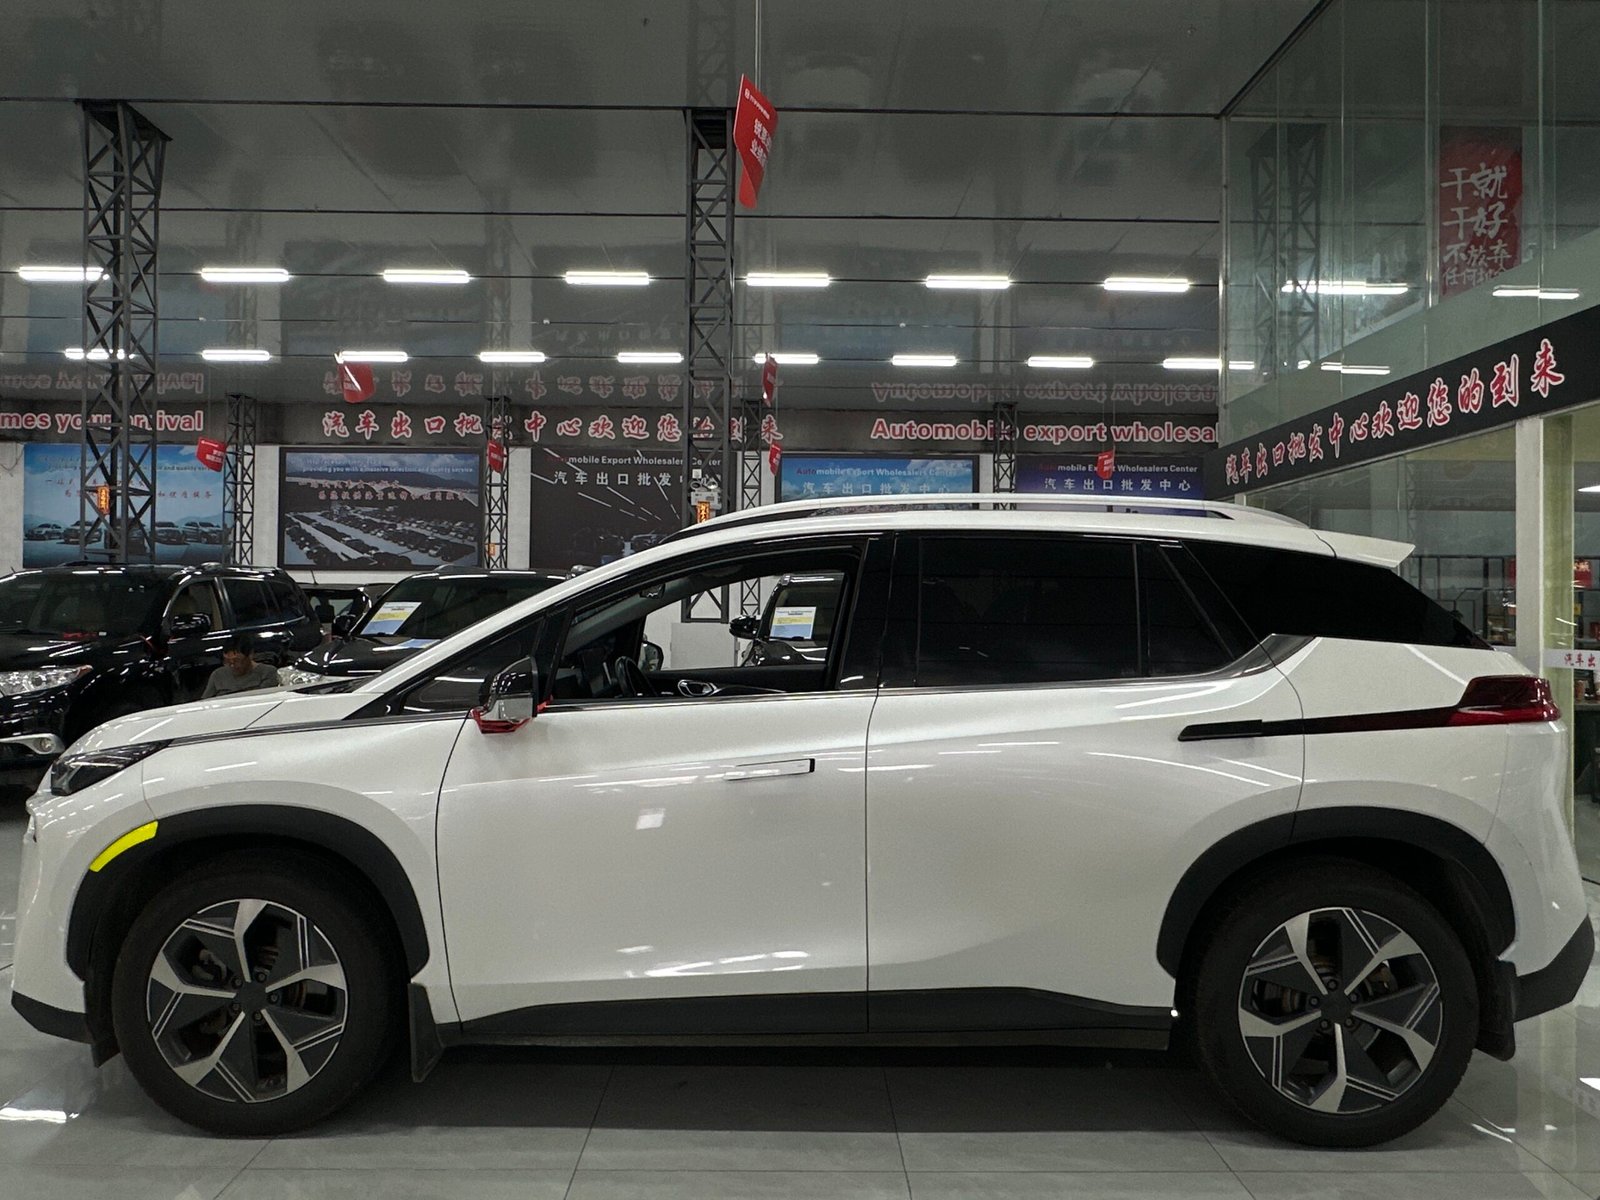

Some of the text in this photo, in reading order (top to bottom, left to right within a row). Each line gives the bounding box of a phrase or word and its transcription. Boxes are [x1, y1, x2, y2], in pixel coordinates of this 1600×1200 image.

[1440, 161, 1508, 201] 干就
[1442, 201, 1508, 240] 干好
[1443, 267, 1506, 286] 任何机
[128, 410, 204, 431] rival
[1225, 337, 1565, 485] 汽车出口批发中心欢迎您的到来
[1024, 421, 1107, 445] export
[601, 455, 631, 466] Export
[633, 456, 684, 466] Wholesaler
[691, 456, 721, 466] Ceter
[1088, 464, 1116, 474] Ext
[1117, 464, 1168, 474] Wholesalers
[1170, 465, 1198, 474] Center
[553, 471, 721, 486] 汽车出口批发心
[1044, 478, 1191, 491] 汽车出口批发中心
[802, 482, 950, 495] 汽车出口批发中心
